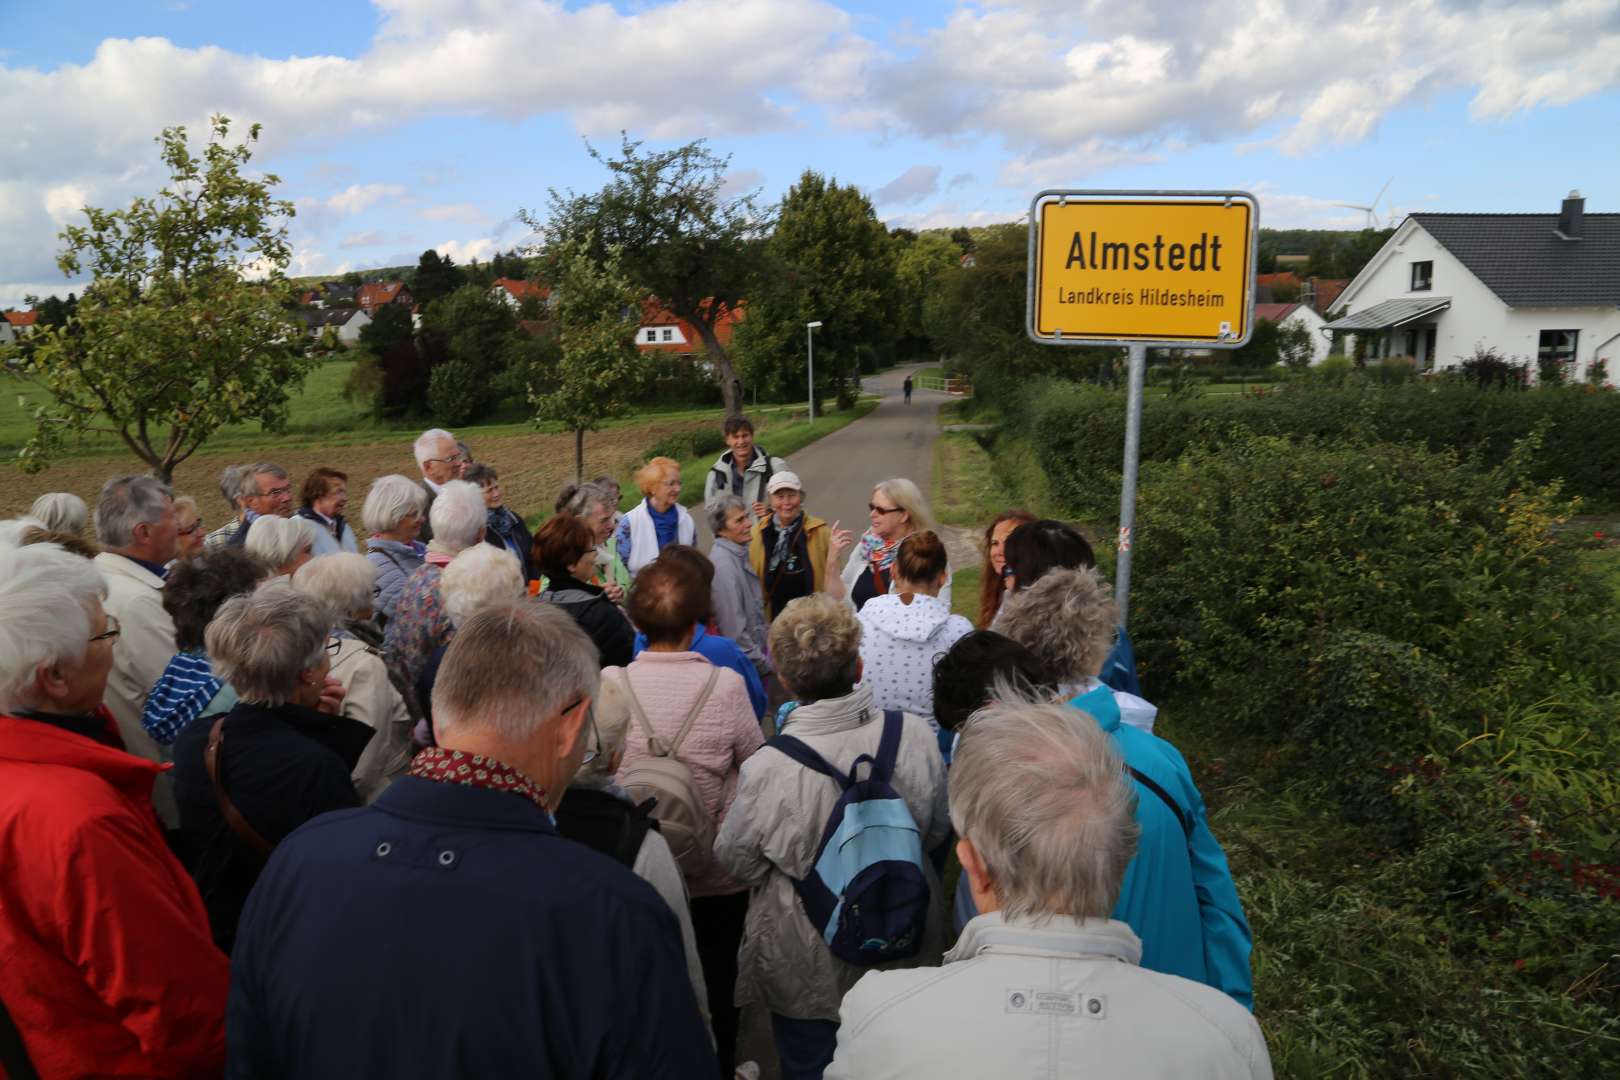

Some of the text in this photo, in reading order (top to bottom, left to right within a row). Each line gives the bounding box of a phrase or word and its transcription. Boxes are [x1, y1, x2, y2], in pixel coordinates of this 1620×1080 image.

[1065, 231, 1222, 272] Almstedt
[1059, 287, 1224, 308] Landkreis Hildesheim
